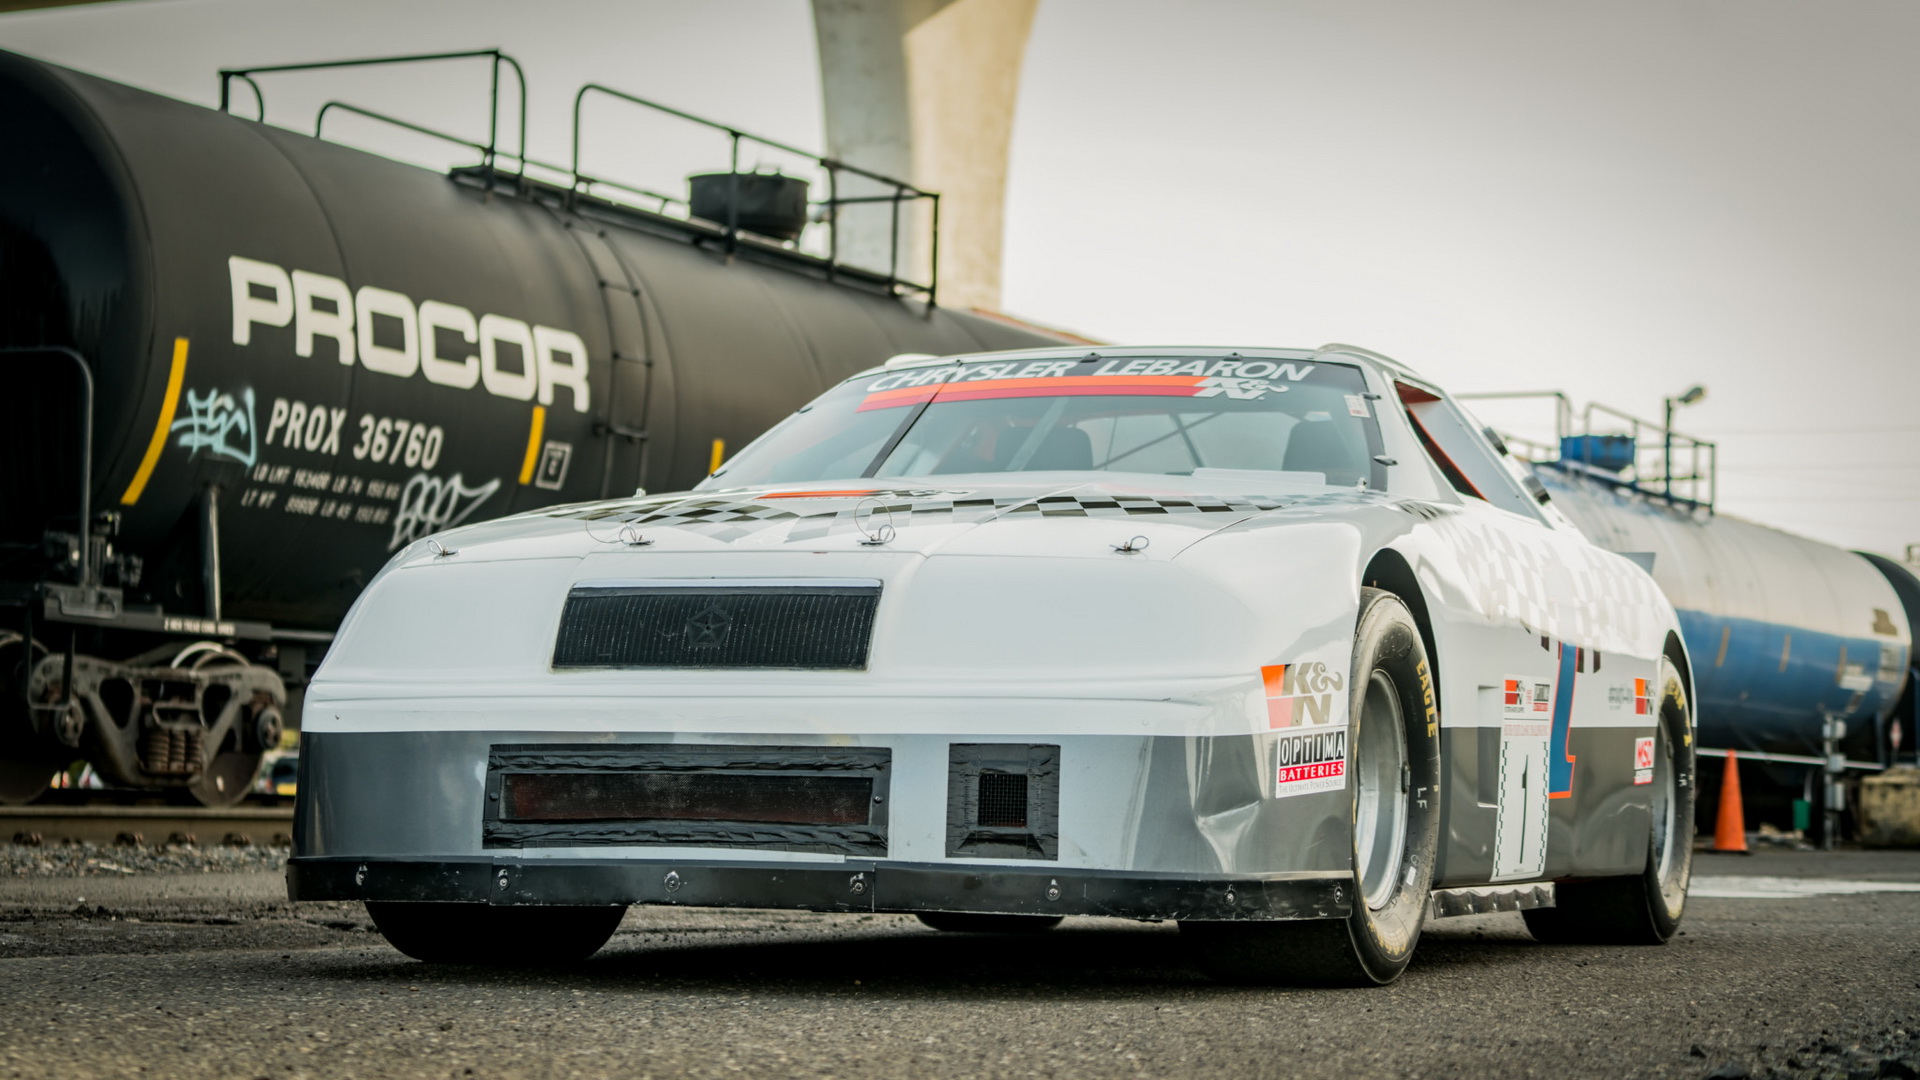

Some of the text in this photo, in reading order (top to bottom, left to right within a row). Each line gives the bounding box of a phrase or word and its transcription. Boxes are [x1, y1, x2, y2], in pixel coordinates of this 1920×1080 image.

[228, 255, 590, 413] PROCOR
[867, 359, 1315, 392] CHRYSLER LEBARON
[265, 398, 346, 455] PROX
[353, 413, 443, 470] 36760
[1416, 661, 1437, 738] EAGLE
[1280, 731, 1345, 766] OPTIMA
[1280, 762, 1344, 781] BATTERIES
